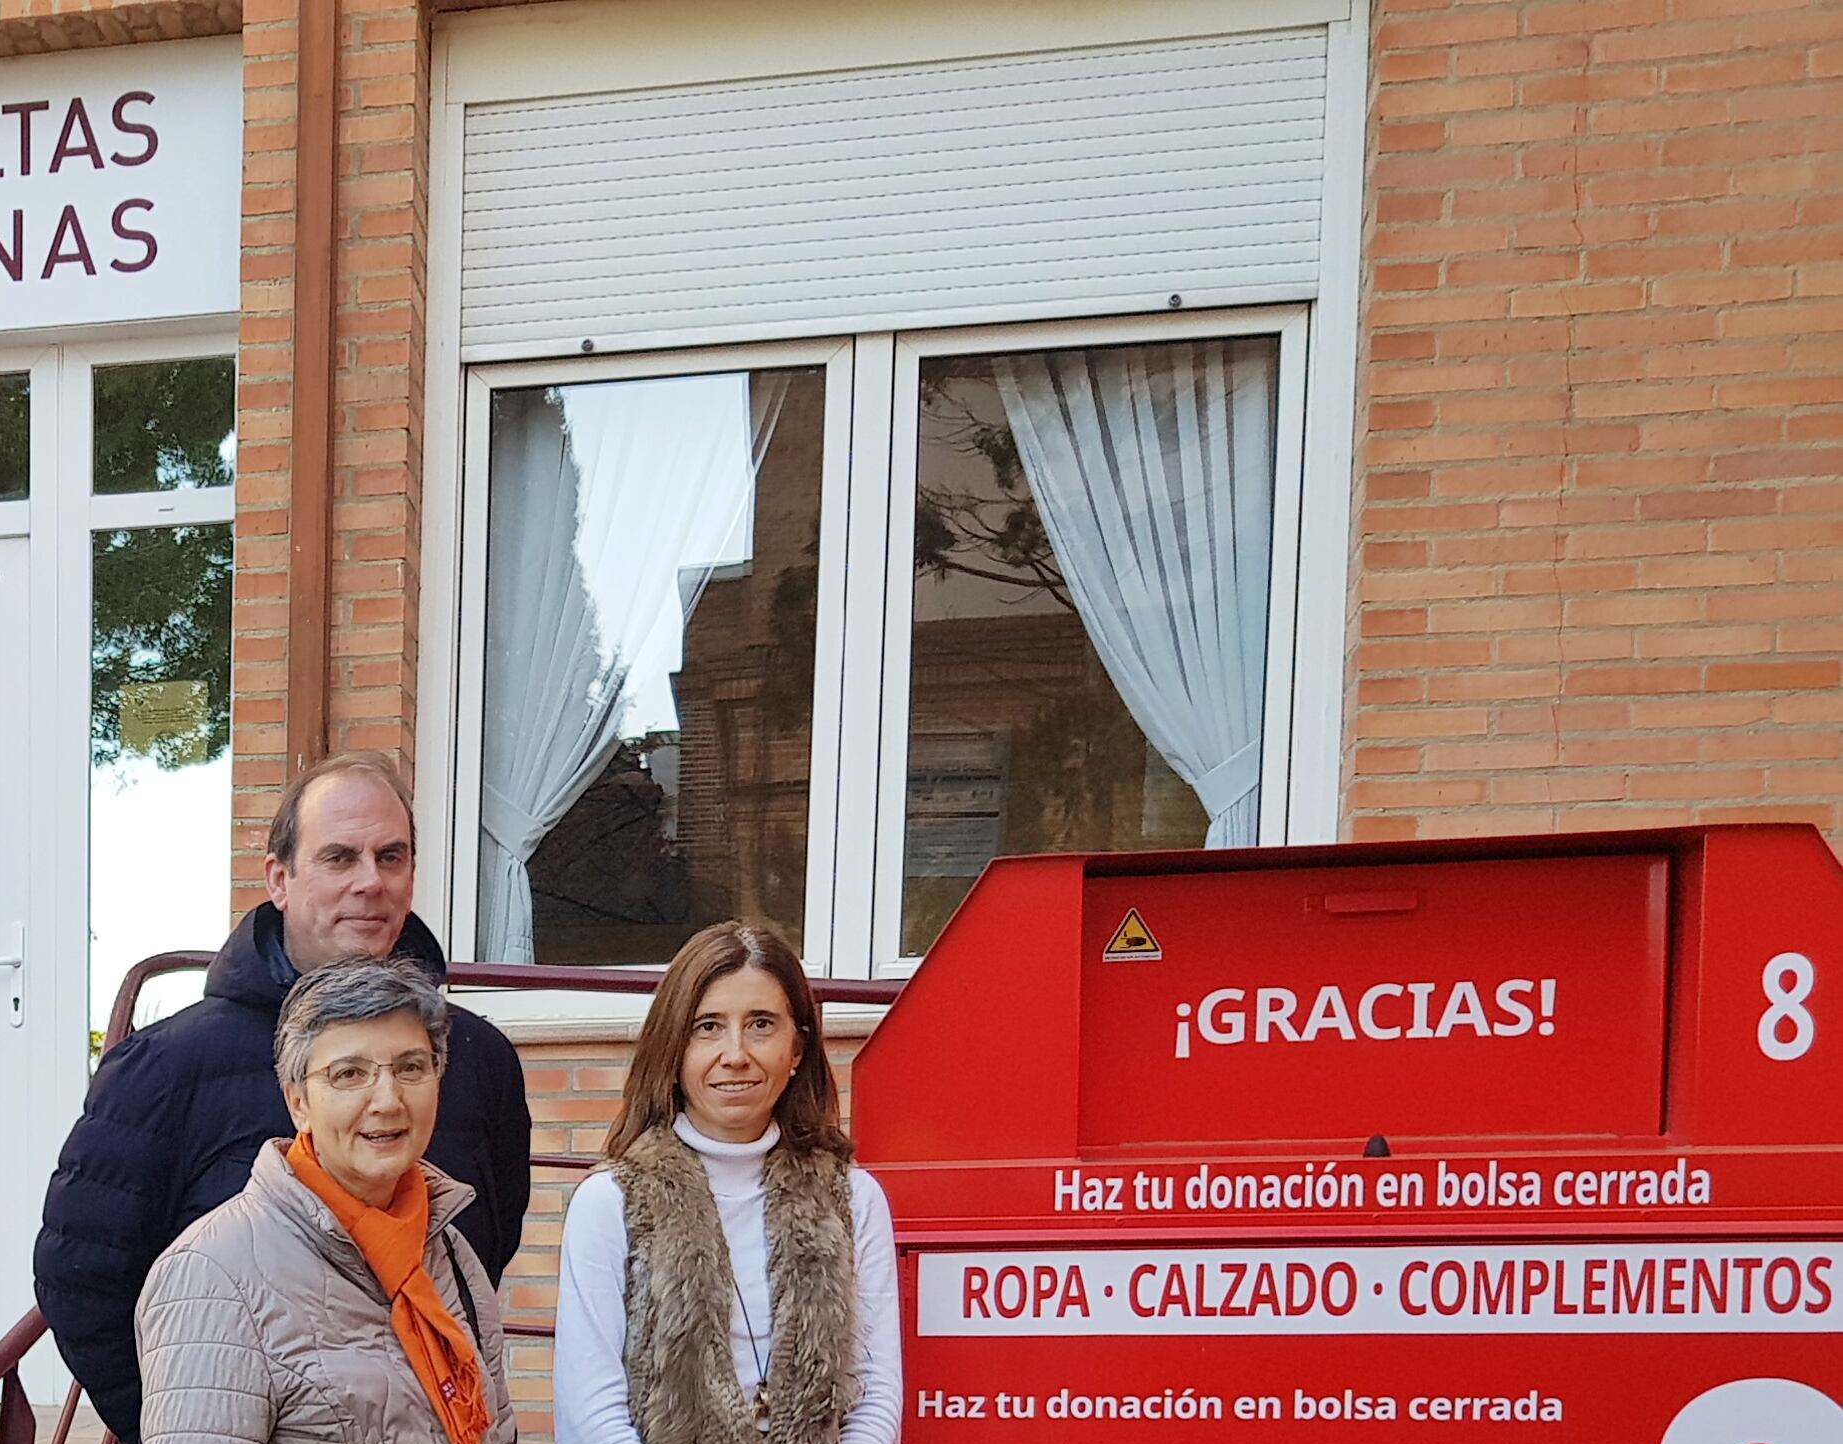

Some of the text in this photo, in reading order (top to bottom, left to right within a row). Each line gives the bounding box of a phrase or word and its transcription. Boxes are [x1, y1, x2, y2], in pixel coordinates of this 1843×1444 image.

[1175, 978, 1557, 1060] ¡GRACIAS!
[1757, 952, 1815, 1061] 8
[1054, 1157, 1711, 1211] Haz tu donación en bolsa cerrada
[961, 1256, 1833, 1319] ROPA CALZADO COMPLEMENTOS
[918, 1387, 1563, 1422] Haz tu donación en bolsa cerrada
